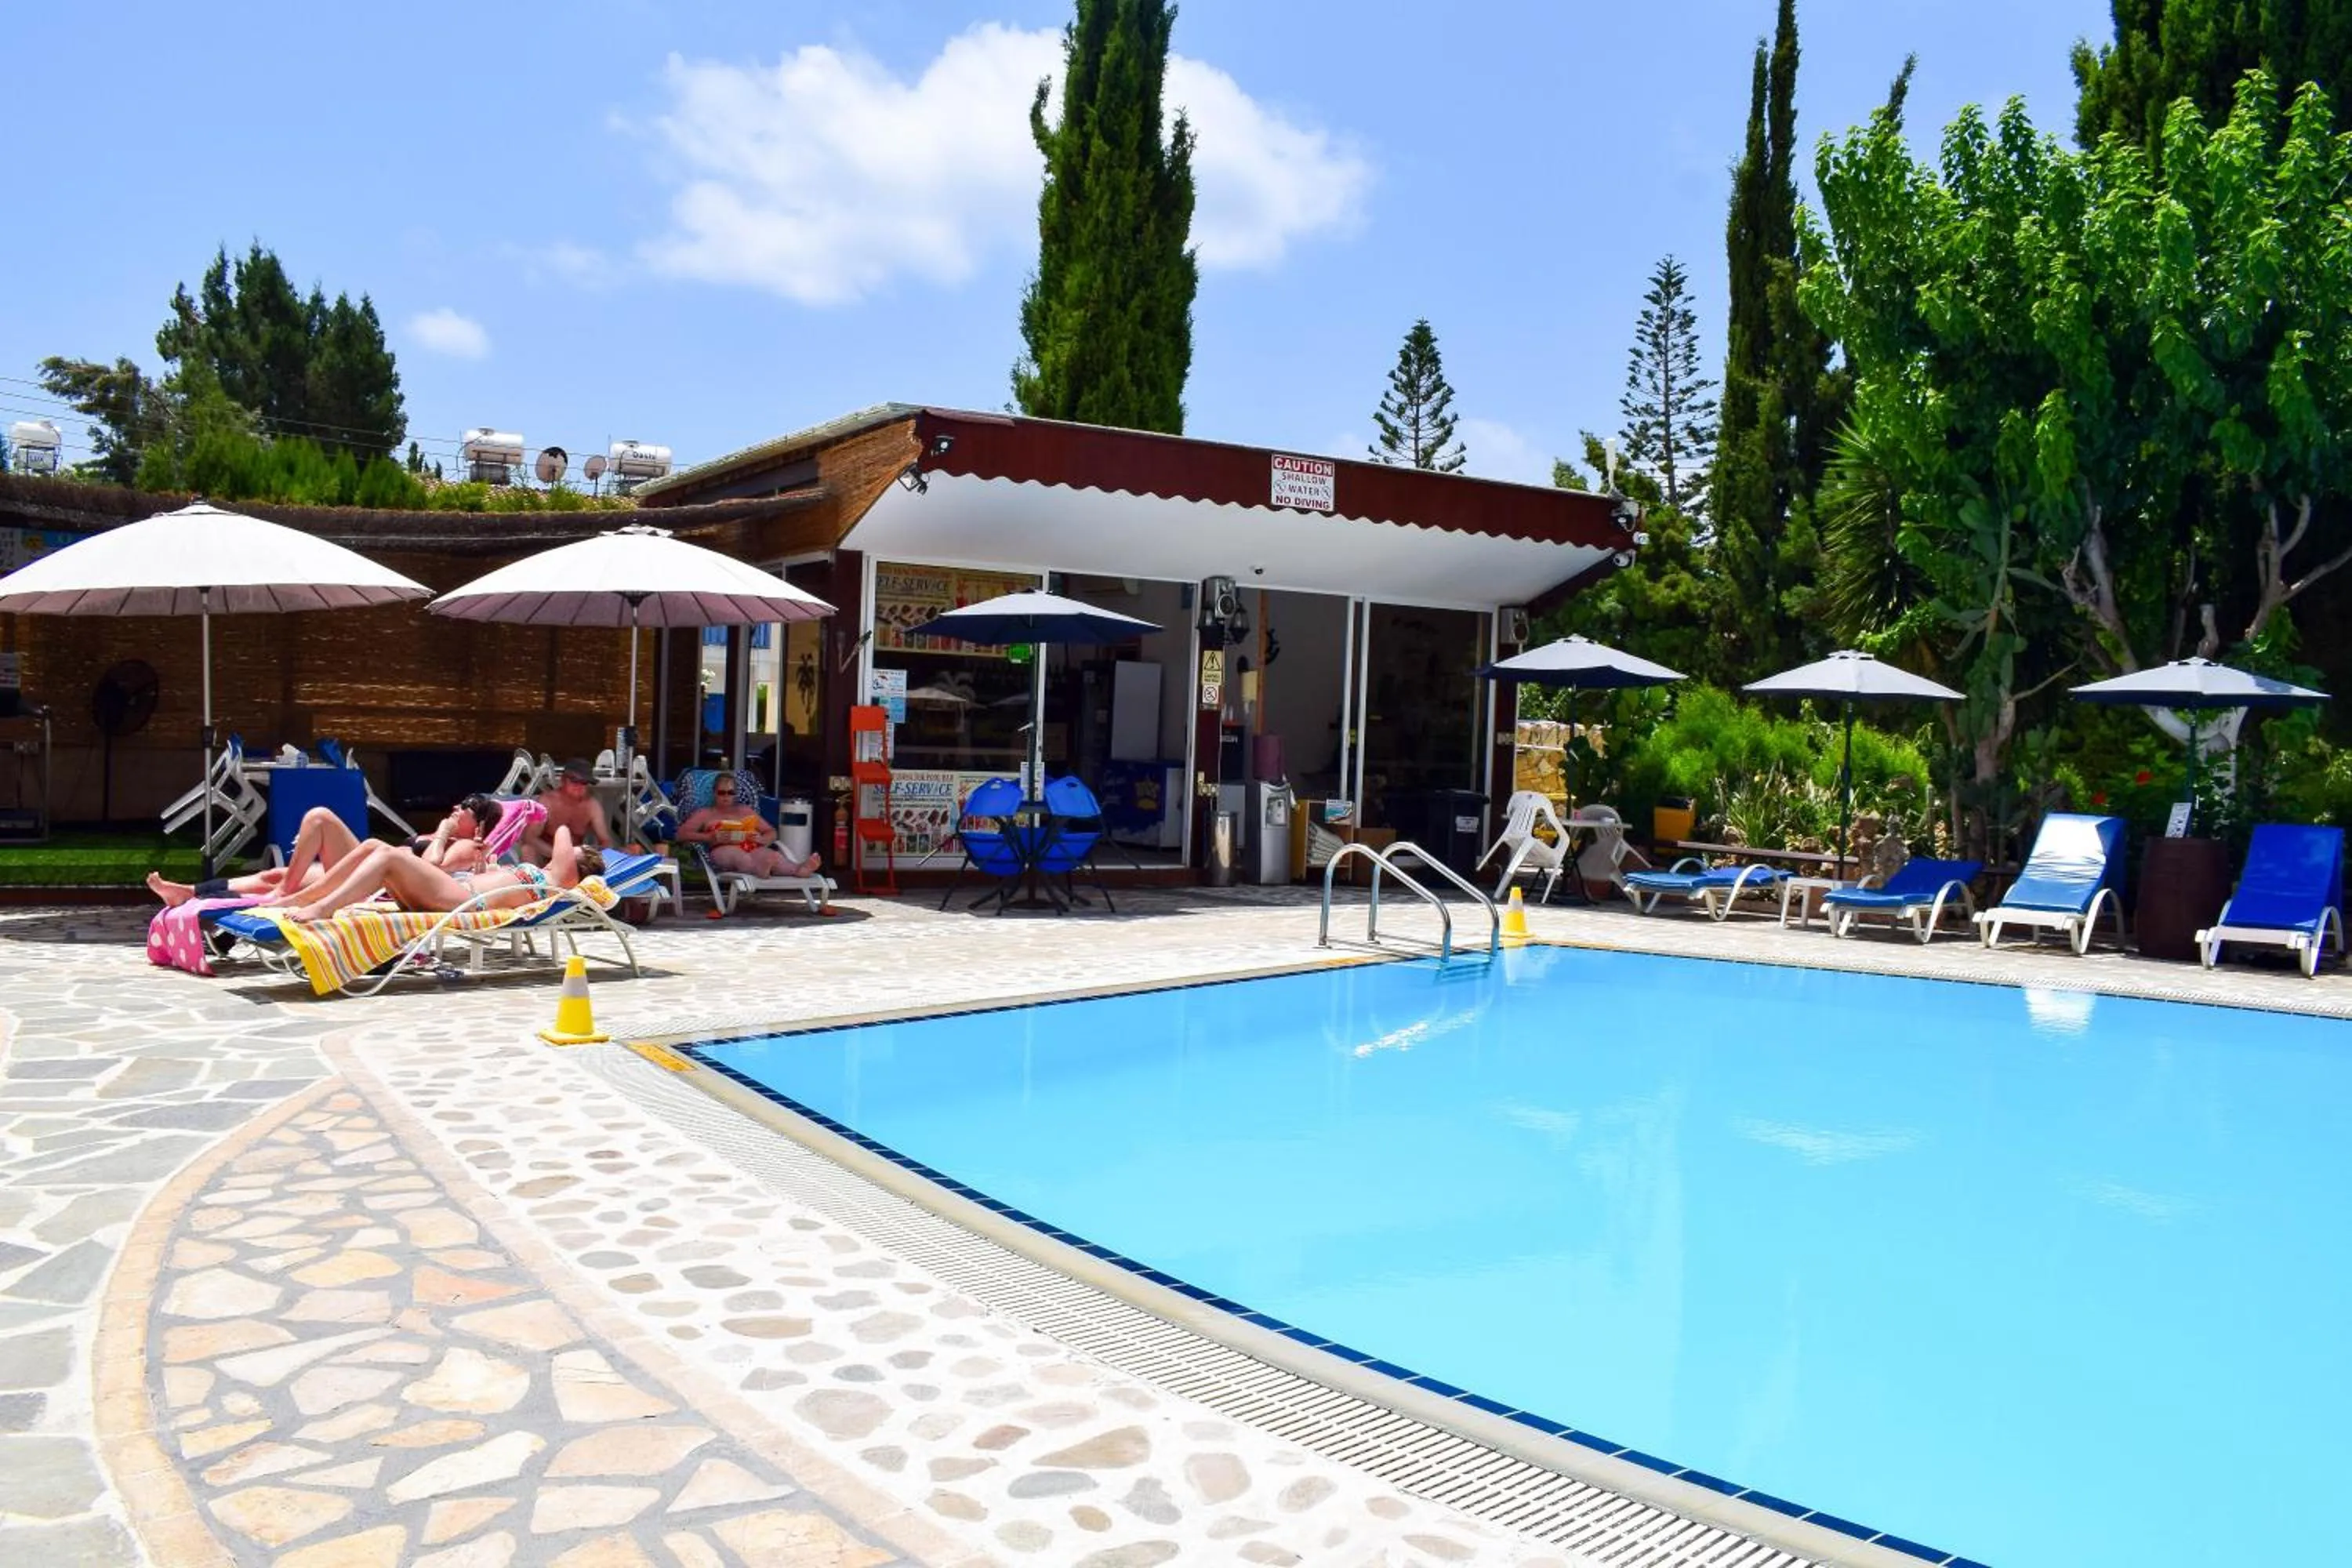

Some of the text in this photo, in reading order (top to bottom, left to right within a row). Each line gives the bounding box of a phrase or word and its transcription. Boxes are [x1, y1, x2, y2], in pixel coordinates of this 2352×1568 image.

[1274, 457, 1332, 475] CAUTION
[1282, 472, 1327, 485] SHALLOW
[1289, 485, 1319, 495] WATER
[1276, 495, 1330, 510] NO DIVING
[877, 576, 949, 591] ELF-SERVICE
[873, 782, 954, 794] SEF-SERVICE
